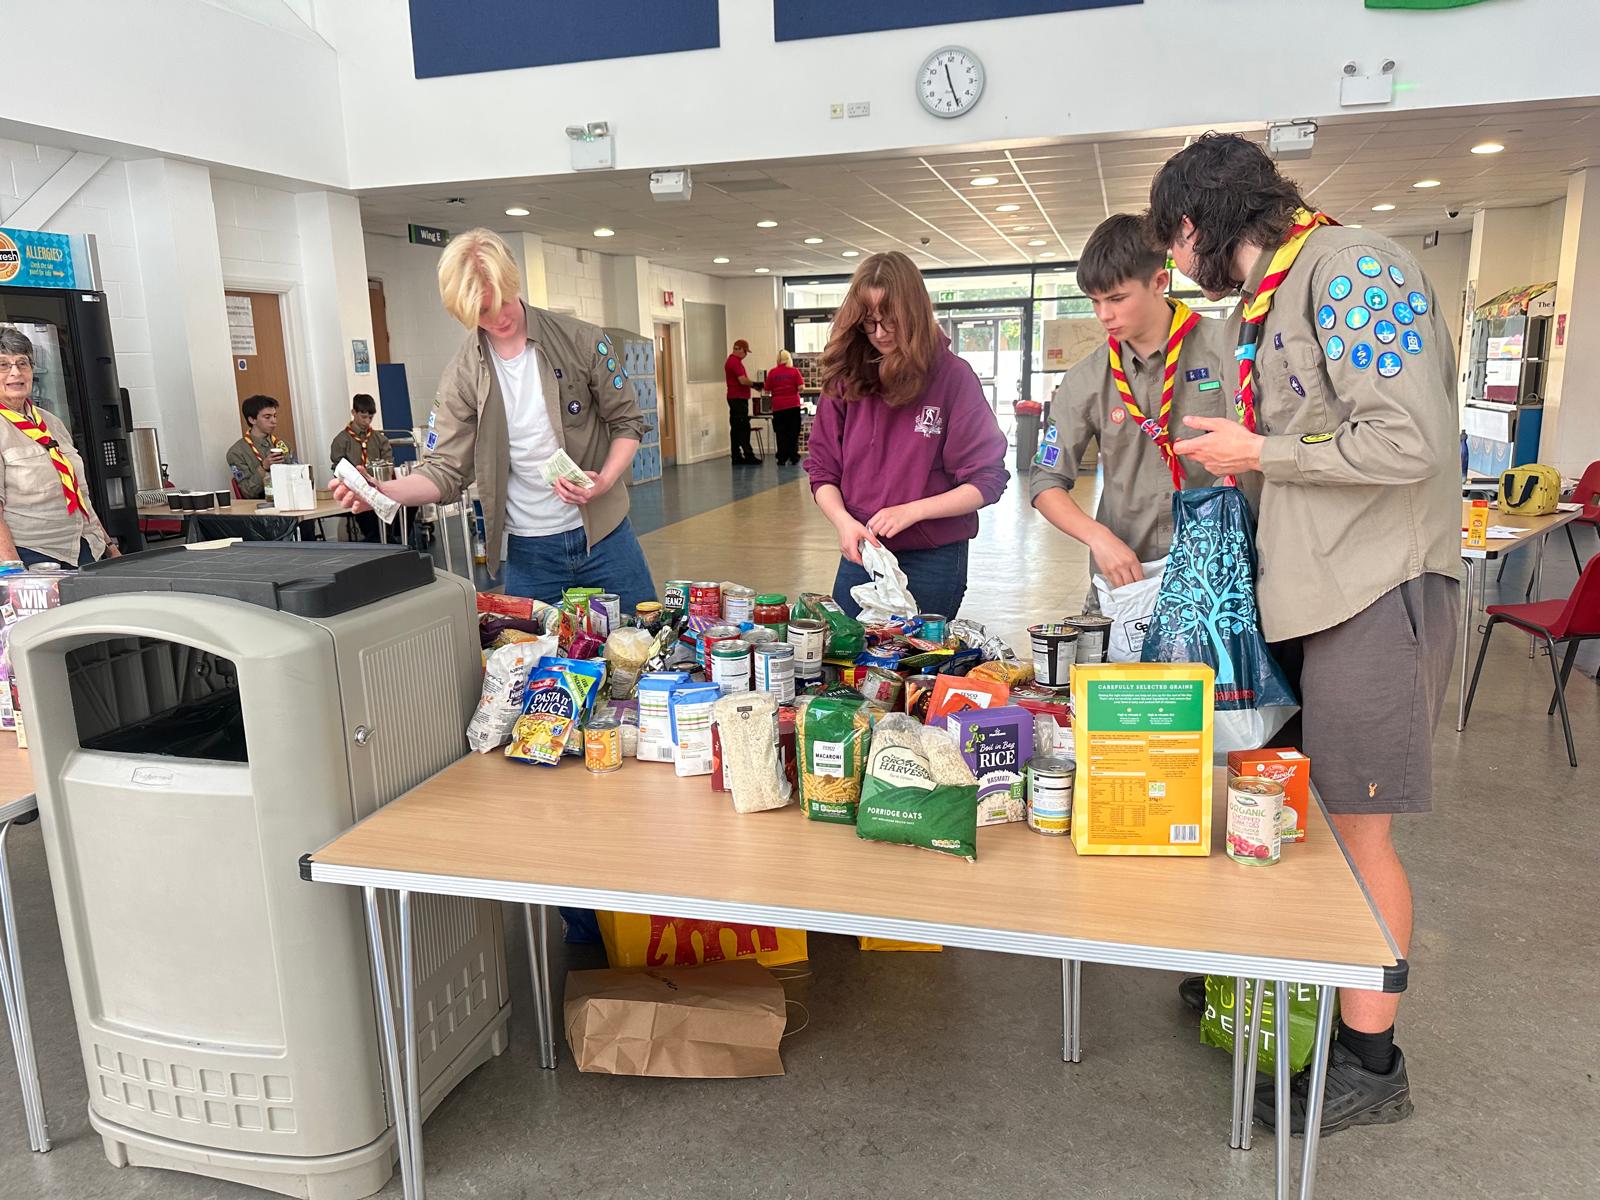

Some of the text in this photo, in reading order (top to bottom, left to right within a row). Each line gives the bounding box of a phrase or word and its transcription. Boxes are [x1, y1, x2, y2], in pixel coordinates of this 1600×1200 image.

[421, 229, 436, 243] Wing
[26, 245, 63, 261] ALLERGIES?
[18, 589, 48, 609] WIN
[534, 692, 561, 704] PASTA
[530, 703, 569, 716] SAUCE
[979, 743, 994, 752] Boil
[1002, 741, 1015, 750] Bag
[980, 750, 1016, 768] RICE
[867, 806, 923, 820] PORRIDGE OATS
[1230, 802, 1266, 817] ORGANIC
